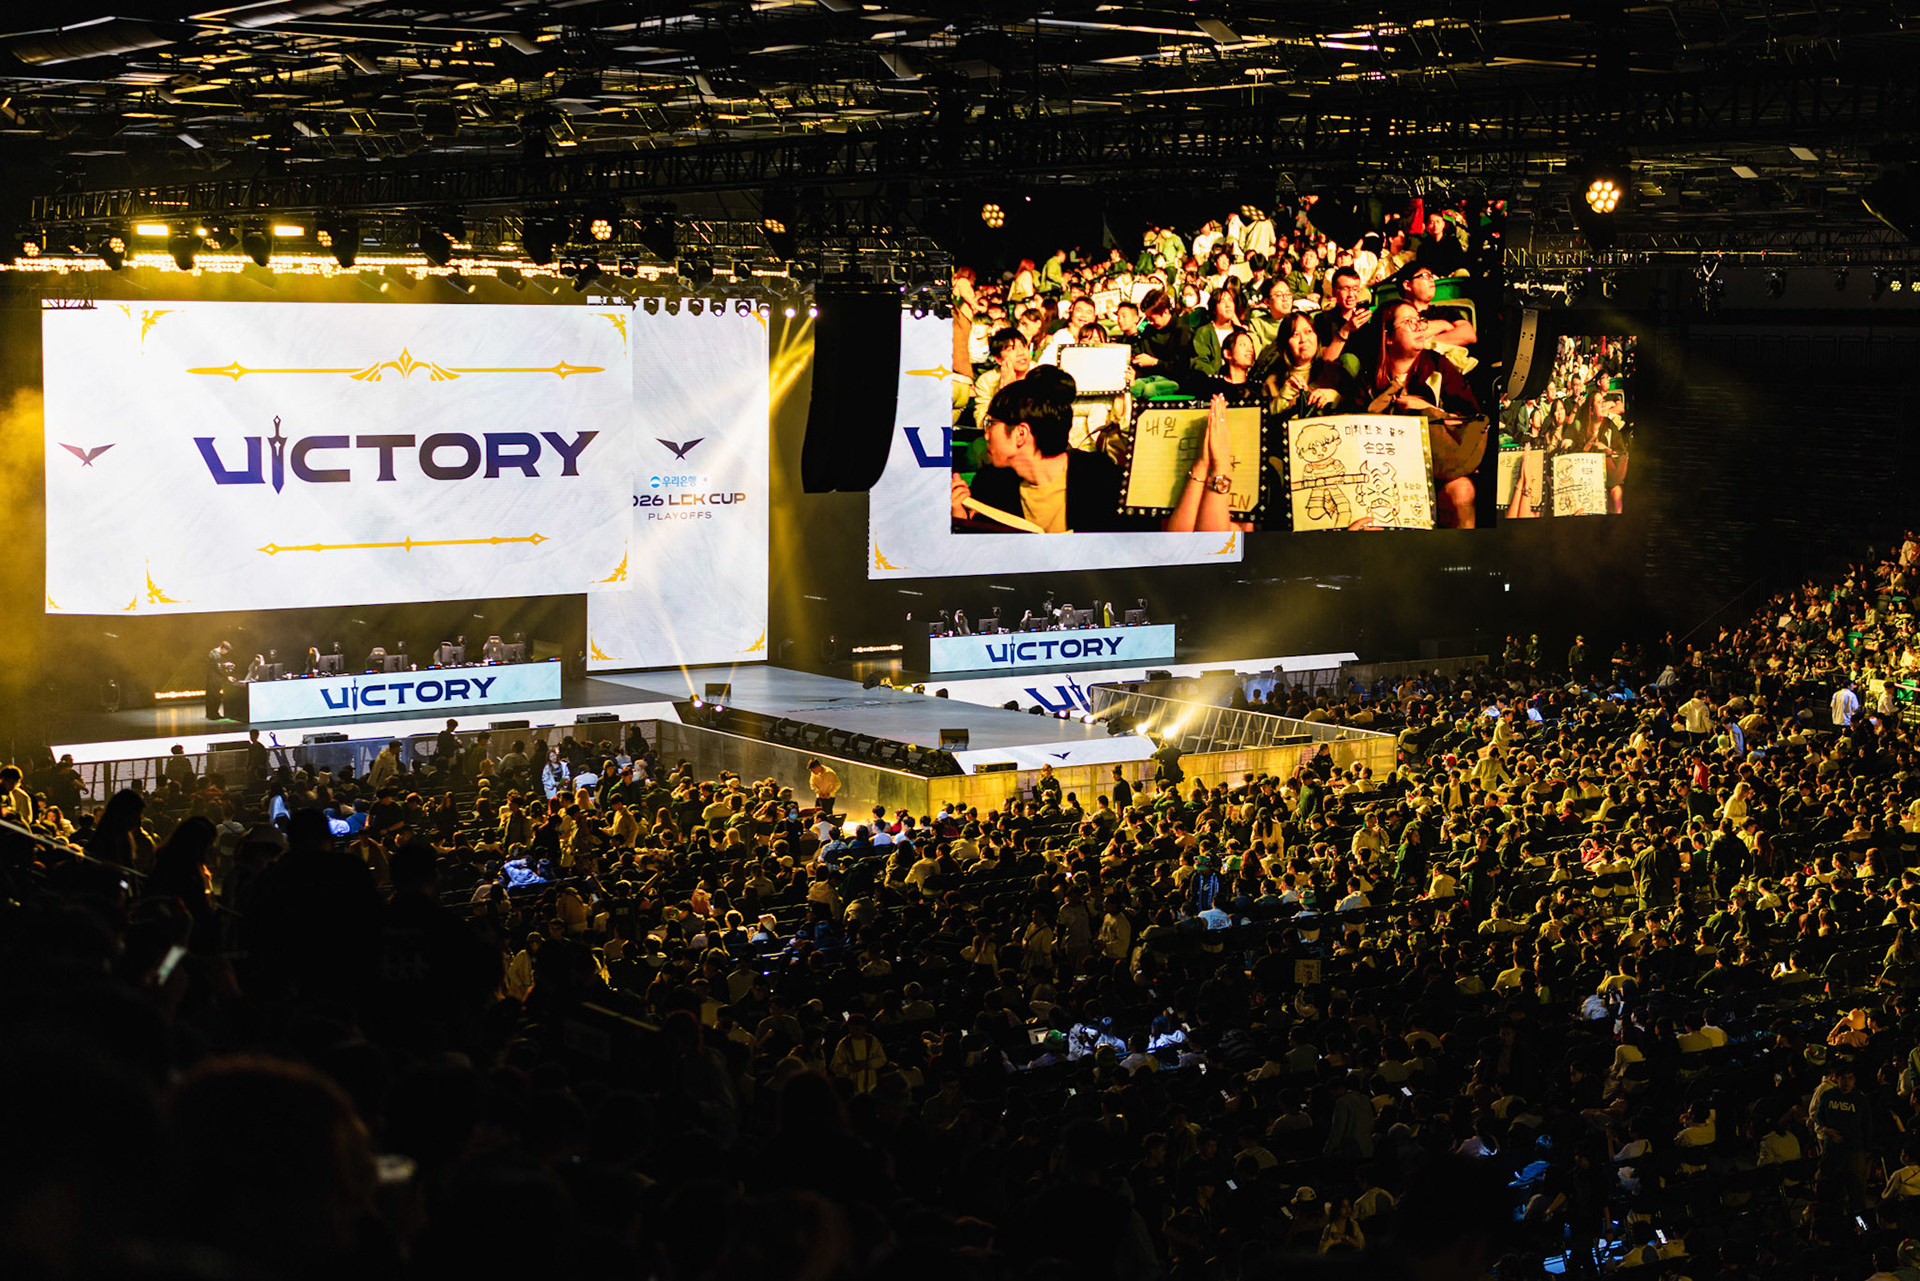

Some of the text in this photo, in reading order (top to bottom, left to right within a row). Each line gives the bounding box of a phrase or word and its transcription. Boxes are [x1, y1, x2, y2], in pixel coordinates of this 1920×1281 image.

[193, 415, 600, 494] VICTORY
[1363, 442, 1396, 456] 손오공
[662, 475, 697, 488] 우리은행
[668, 494, 706, 506] LCK
[708, 492, 746, 504] CUP
[648, 511, 712, 521] PLAYOFFS
[985, 635, 1124, 665] VICTORY
[320, 677, 497, 712] VICTORY
[1828, 1100, 1856, 1112] NASA
